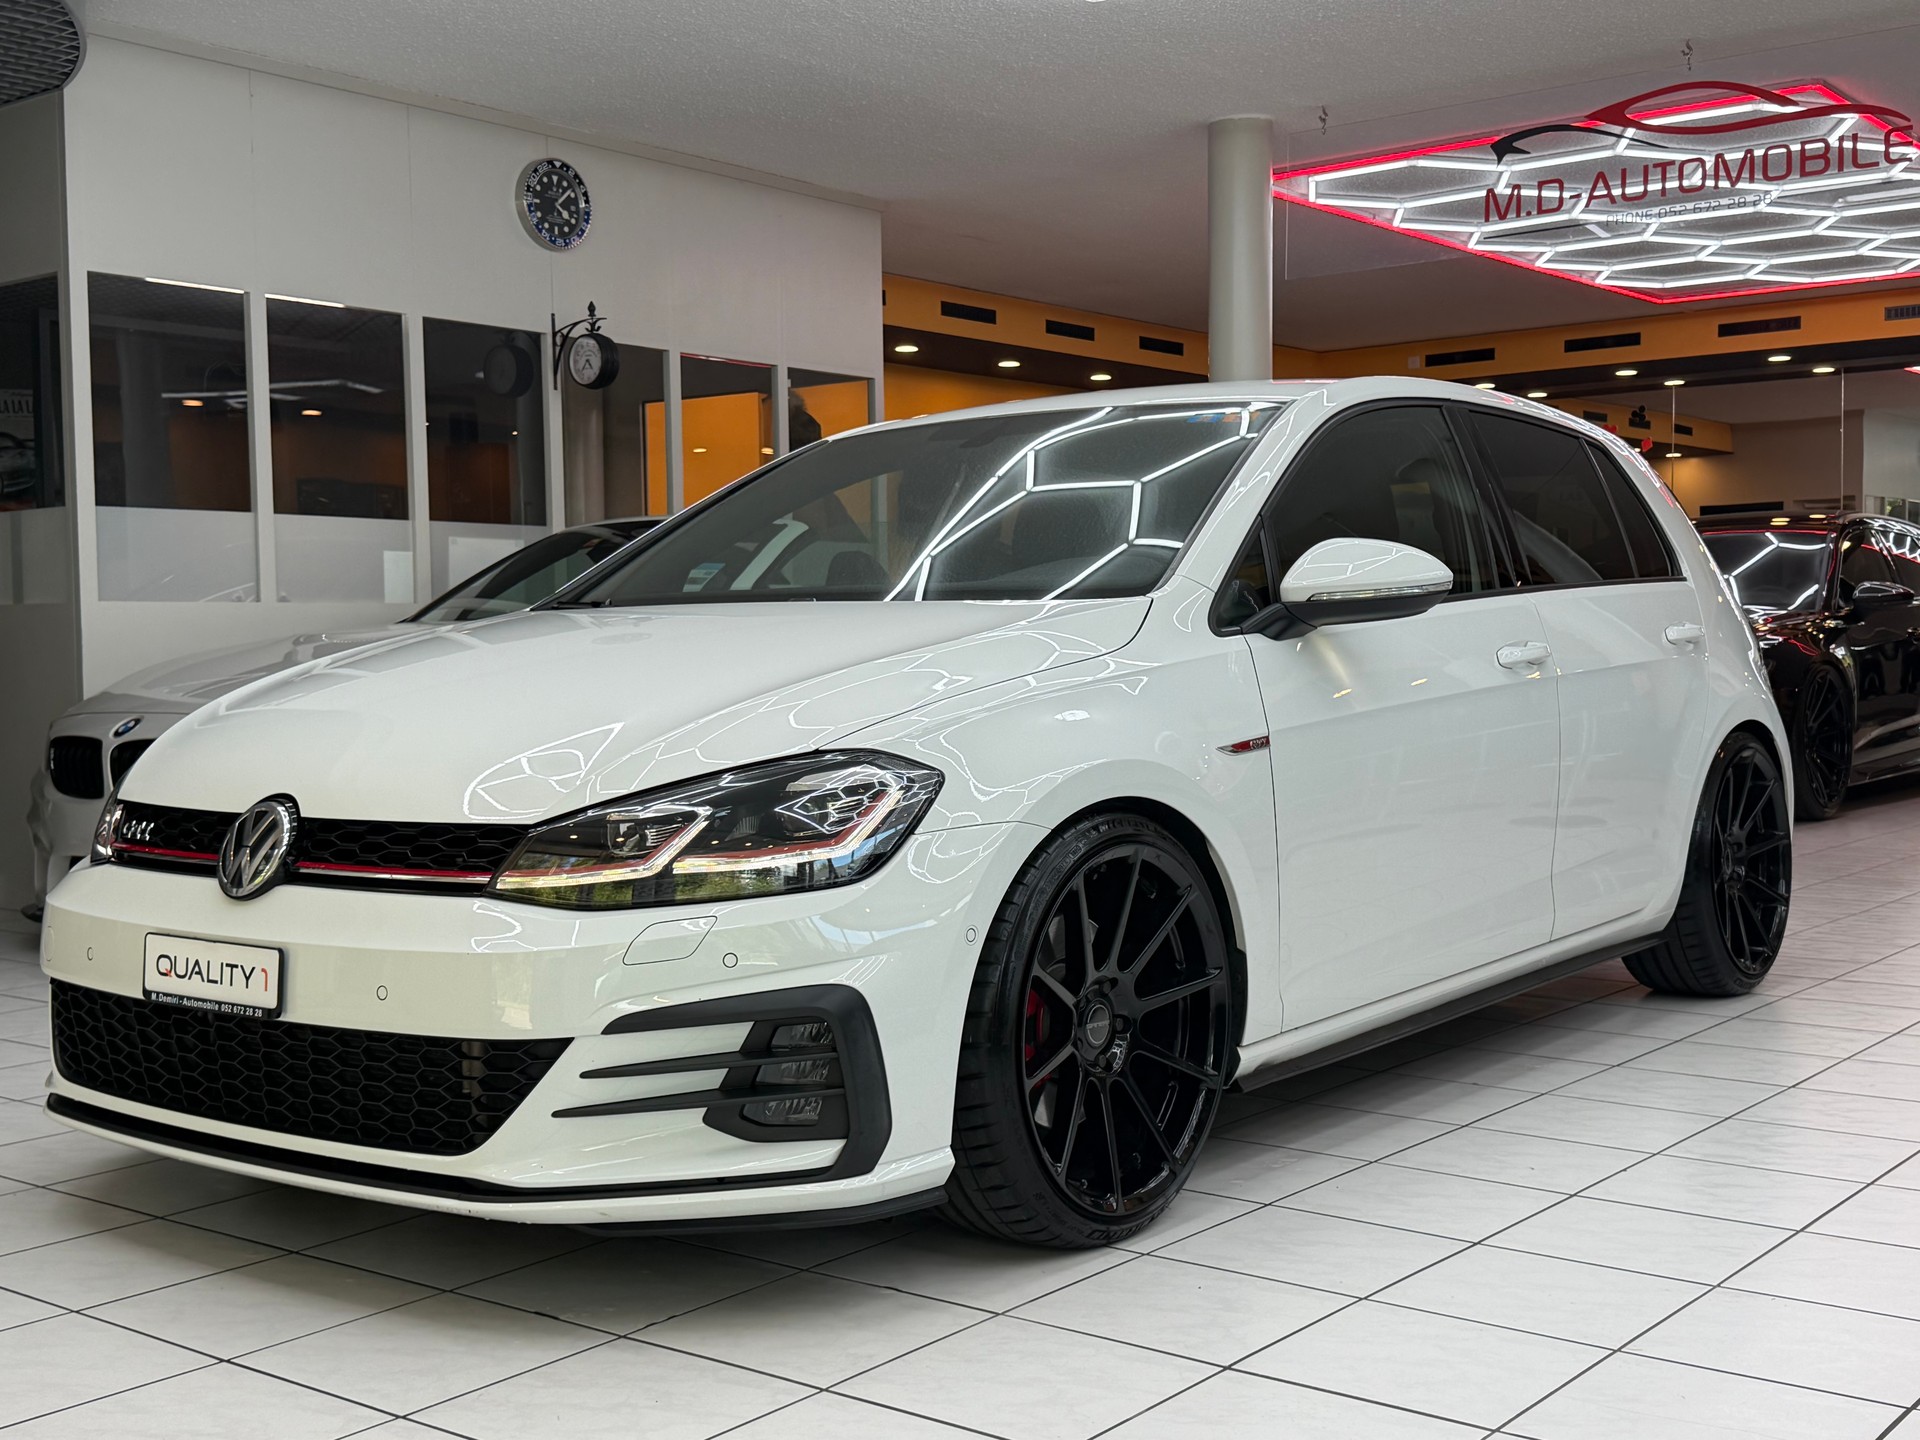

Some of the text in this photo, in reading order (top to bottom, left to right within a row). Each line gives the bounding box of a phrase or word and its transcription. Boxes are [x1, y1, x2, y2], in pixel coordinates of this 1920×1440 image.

[1484, 124, 1914, 223] M.D-AUTOMOBILE
[1606, 209, 1653, 226] PHONE
[1658, 205, 1687, 219] 052
[1693, 200, 1721, 214] 672
[1727, 197, 1747, 209] 28
[220, 1003, 232, 1013] 052
[233, 1005, 244, 1015] 672
[245, 1007, 254, 1016] 28
[254, 1008, 263, 1018] 28
